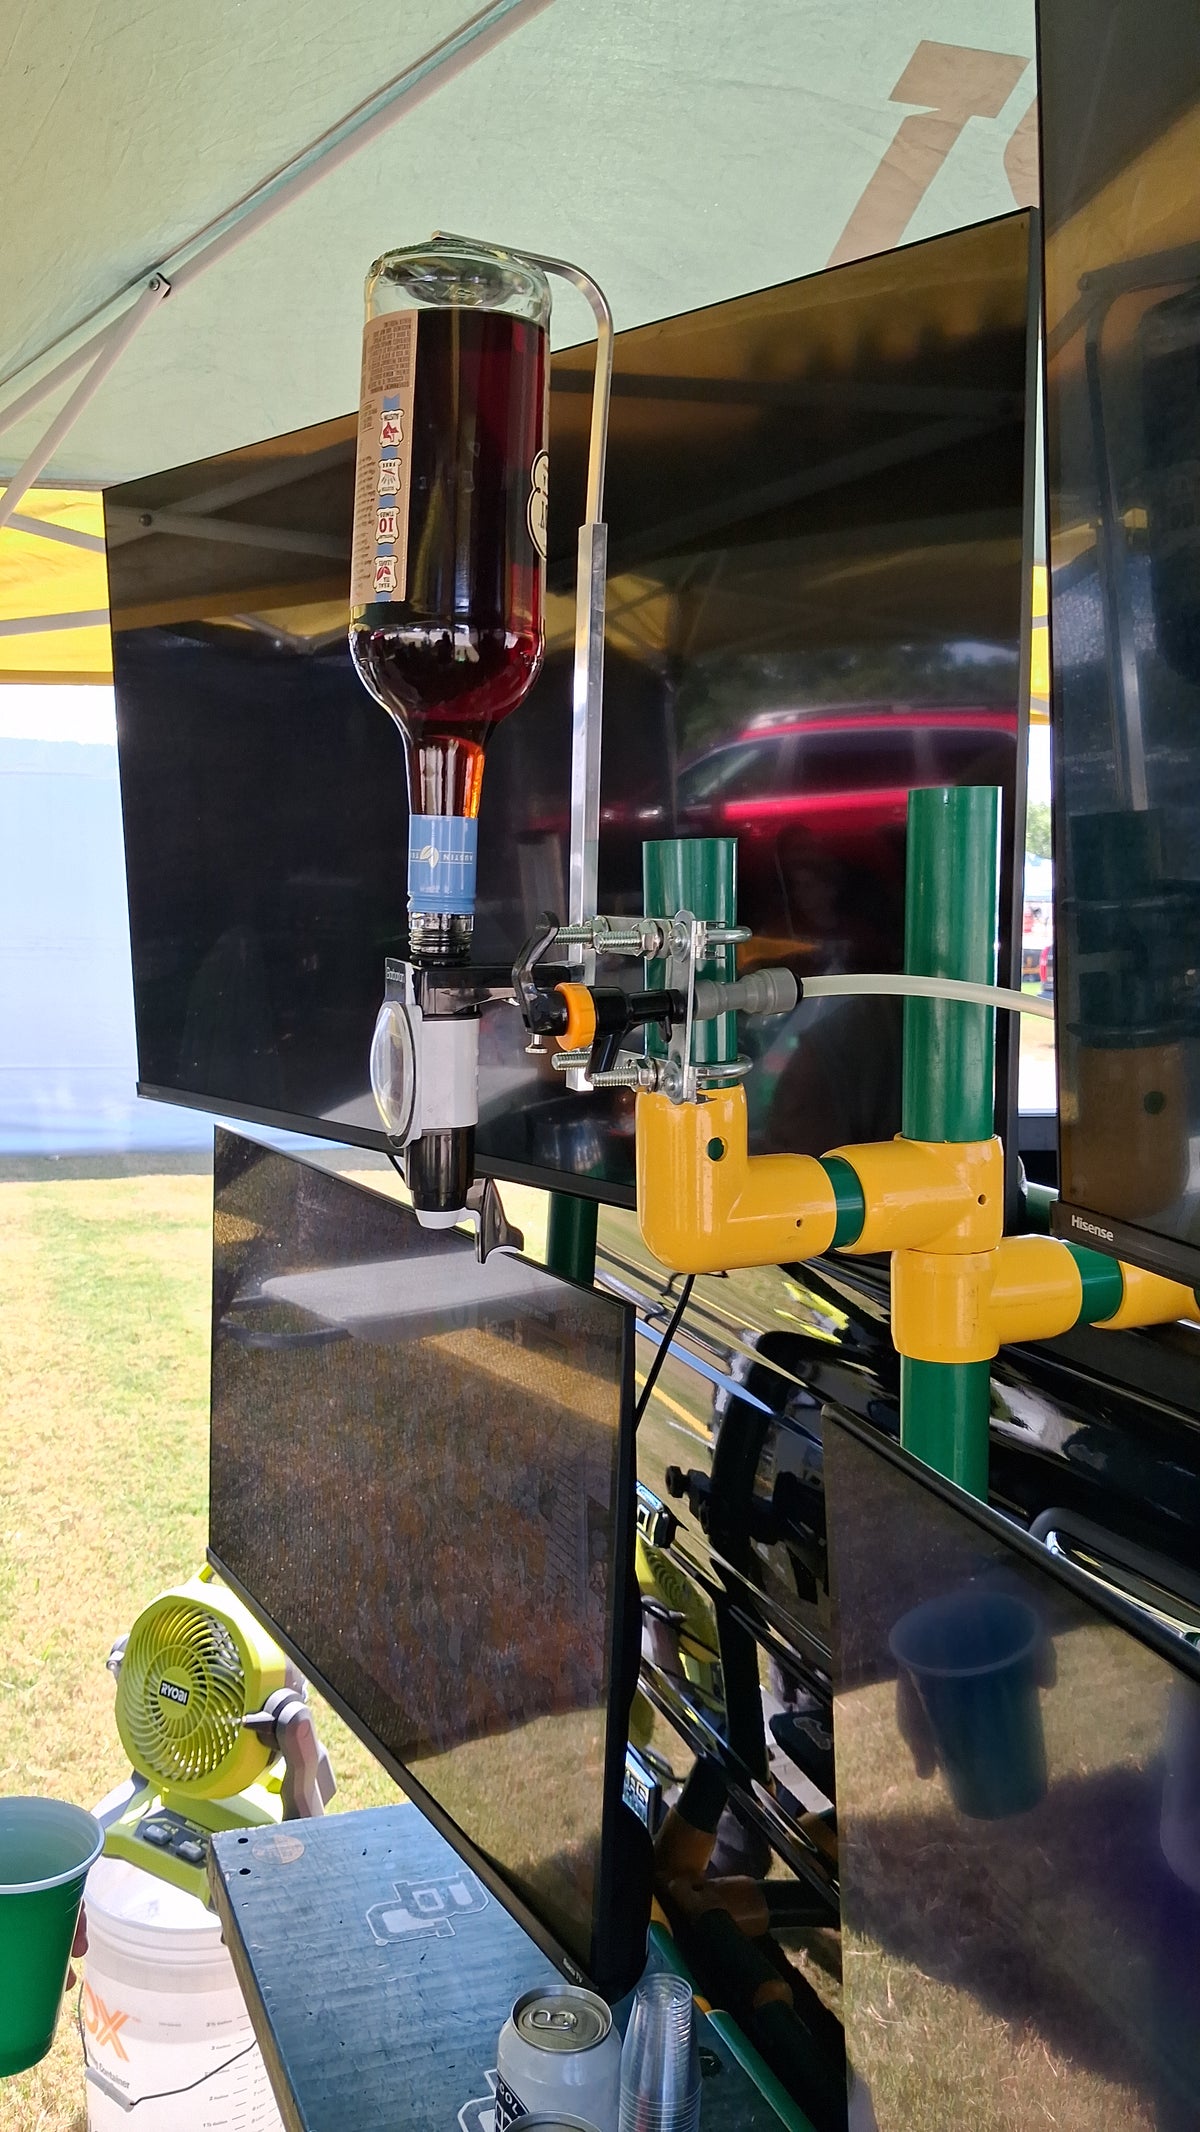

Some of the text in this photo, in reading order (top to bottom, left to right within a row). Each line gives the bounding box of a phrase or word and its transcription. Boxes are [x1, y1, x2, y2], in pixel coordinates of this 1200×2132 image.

[379, 517, 394, 533] 10
[1071, 1214, 1114, 1242] Hisense
[160, 1682, 188, 1704] RYOBI
